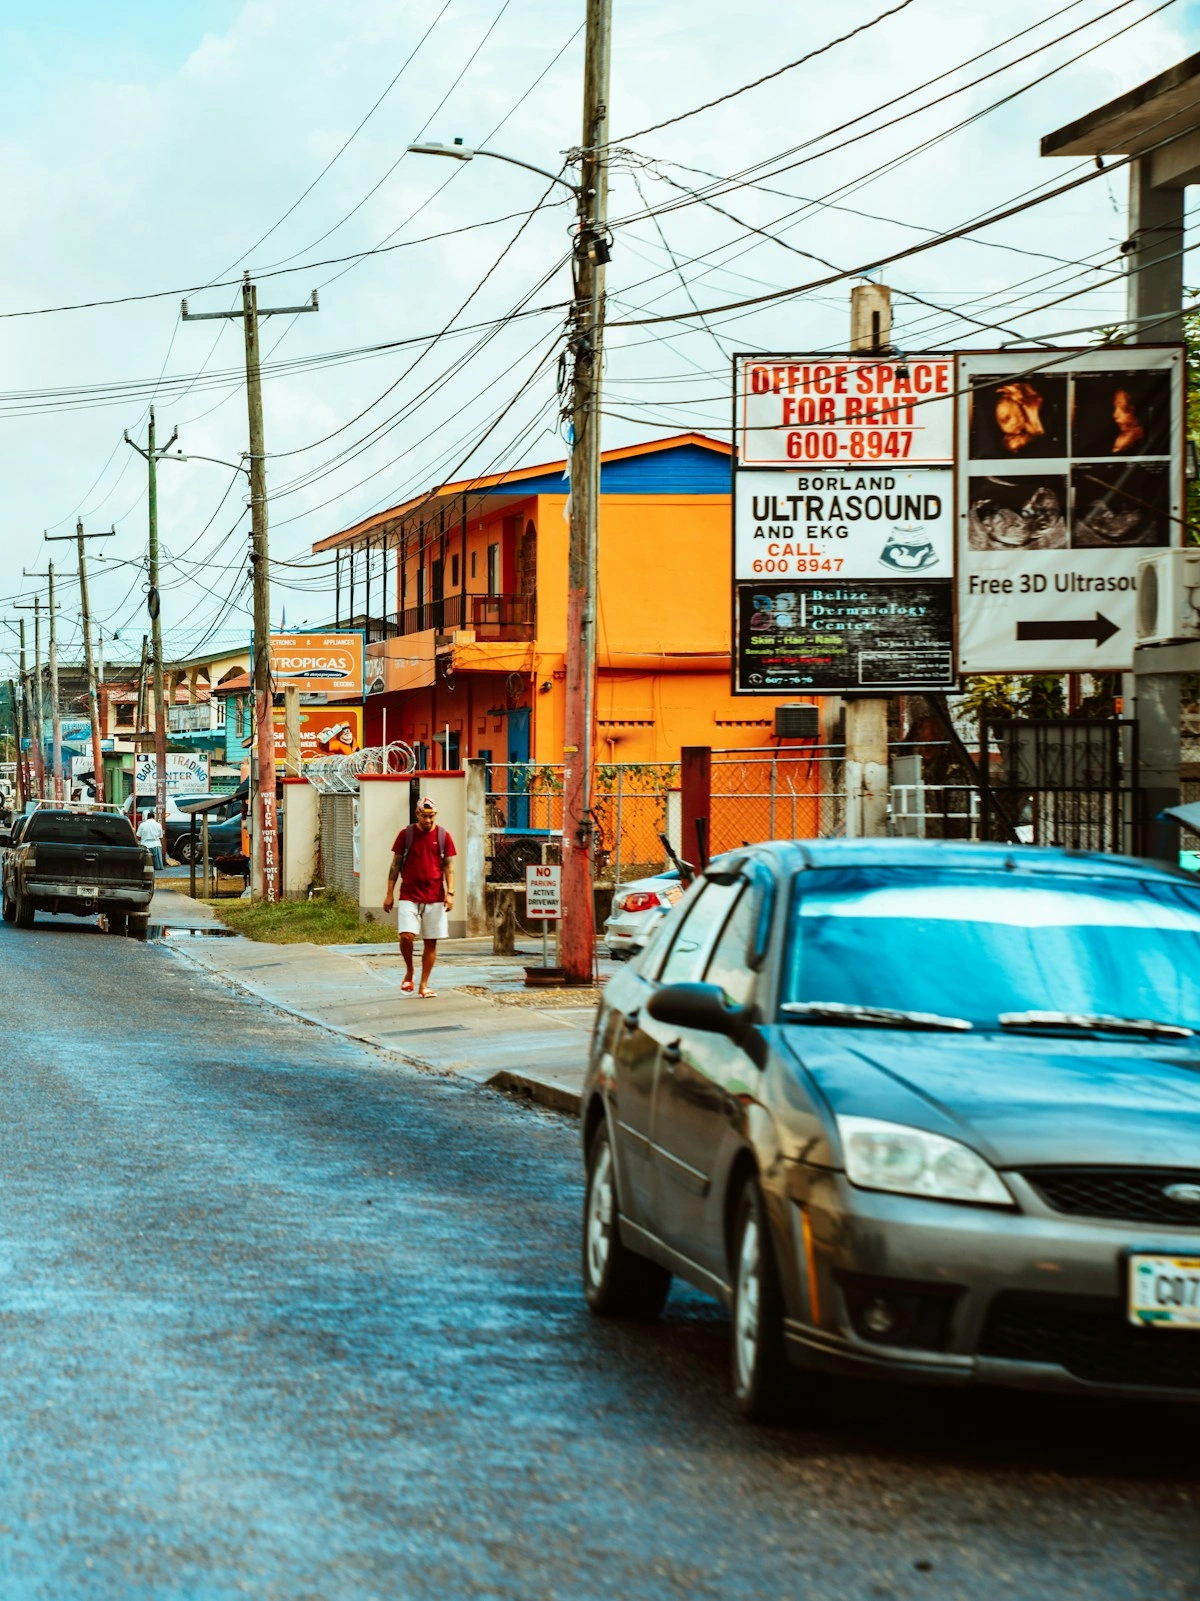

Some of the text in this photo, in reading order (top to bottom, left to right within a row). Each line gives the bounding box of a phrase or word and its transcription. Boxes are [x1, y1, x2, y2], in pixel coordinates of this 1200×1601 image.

[752, 365, 949, 395] OFFICE SPACE
[783, 397, 918, 425] FOR RENT
[786, 431, 913, 459] 600-8947
[798, 477, 896, 490] BORLAND
[752, 495, 942, 521] ULTRASOUND
[753, 525, 849, 539] AND EKG
[753, 558, 845, 573] 600 8947
[969, 575, 1013, 594] Free
[1020, 574, 1047, 593] 3D
[812, 590, 868, 600] Belize
[812, 603, 926, 616] Dermatology
[812, 620, 872, 630] Center
[750, 636, 775, 645] Skin
[784, 637, 806, 645] Hair
[815, 636, 842, 645] Nails
[271, 657, 347, 669] TROPIGAS
[152, 771, 192, 780] CNTER
[172, 755, 208, 782] TRADING
[264, 798, 272, 827] NICK
[264, 836, 274, 865] NICK
[536, 867, 552, 877] NO
[267, 874, 275, 902] NICK
